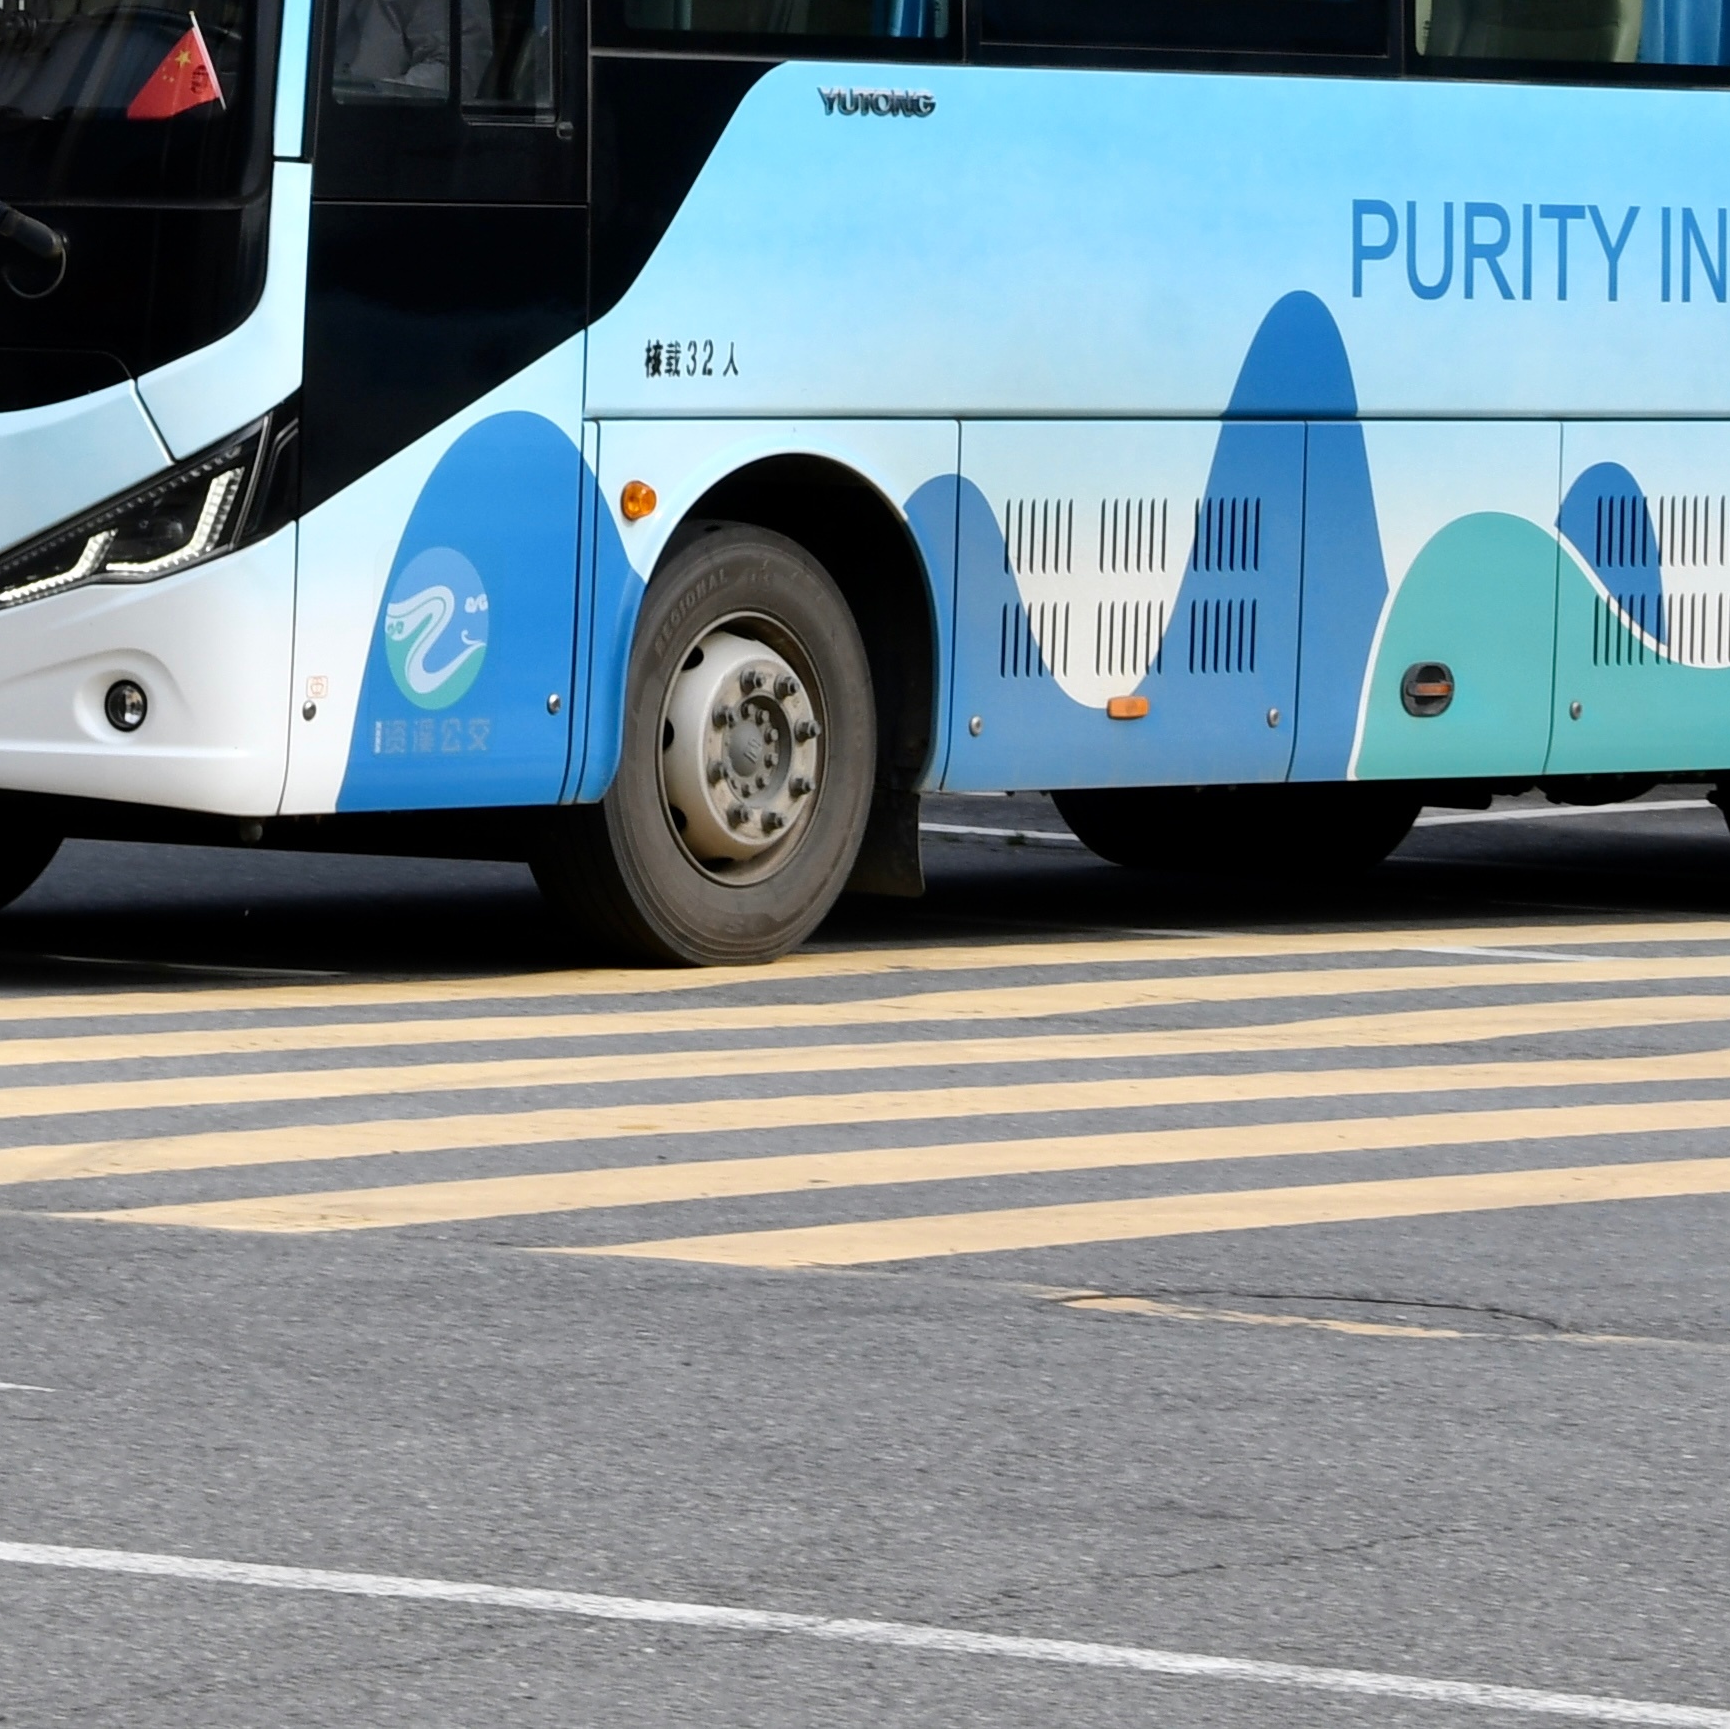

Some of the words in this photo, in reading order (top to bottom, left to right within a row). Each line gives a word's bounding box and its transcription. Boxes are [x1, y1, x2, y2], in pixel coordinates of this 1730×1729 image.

[817, 87, 936, 118] YUTONG
[1352, 198, 1641, 303] PURITY
[1661, 206, 1727, 304] IN
